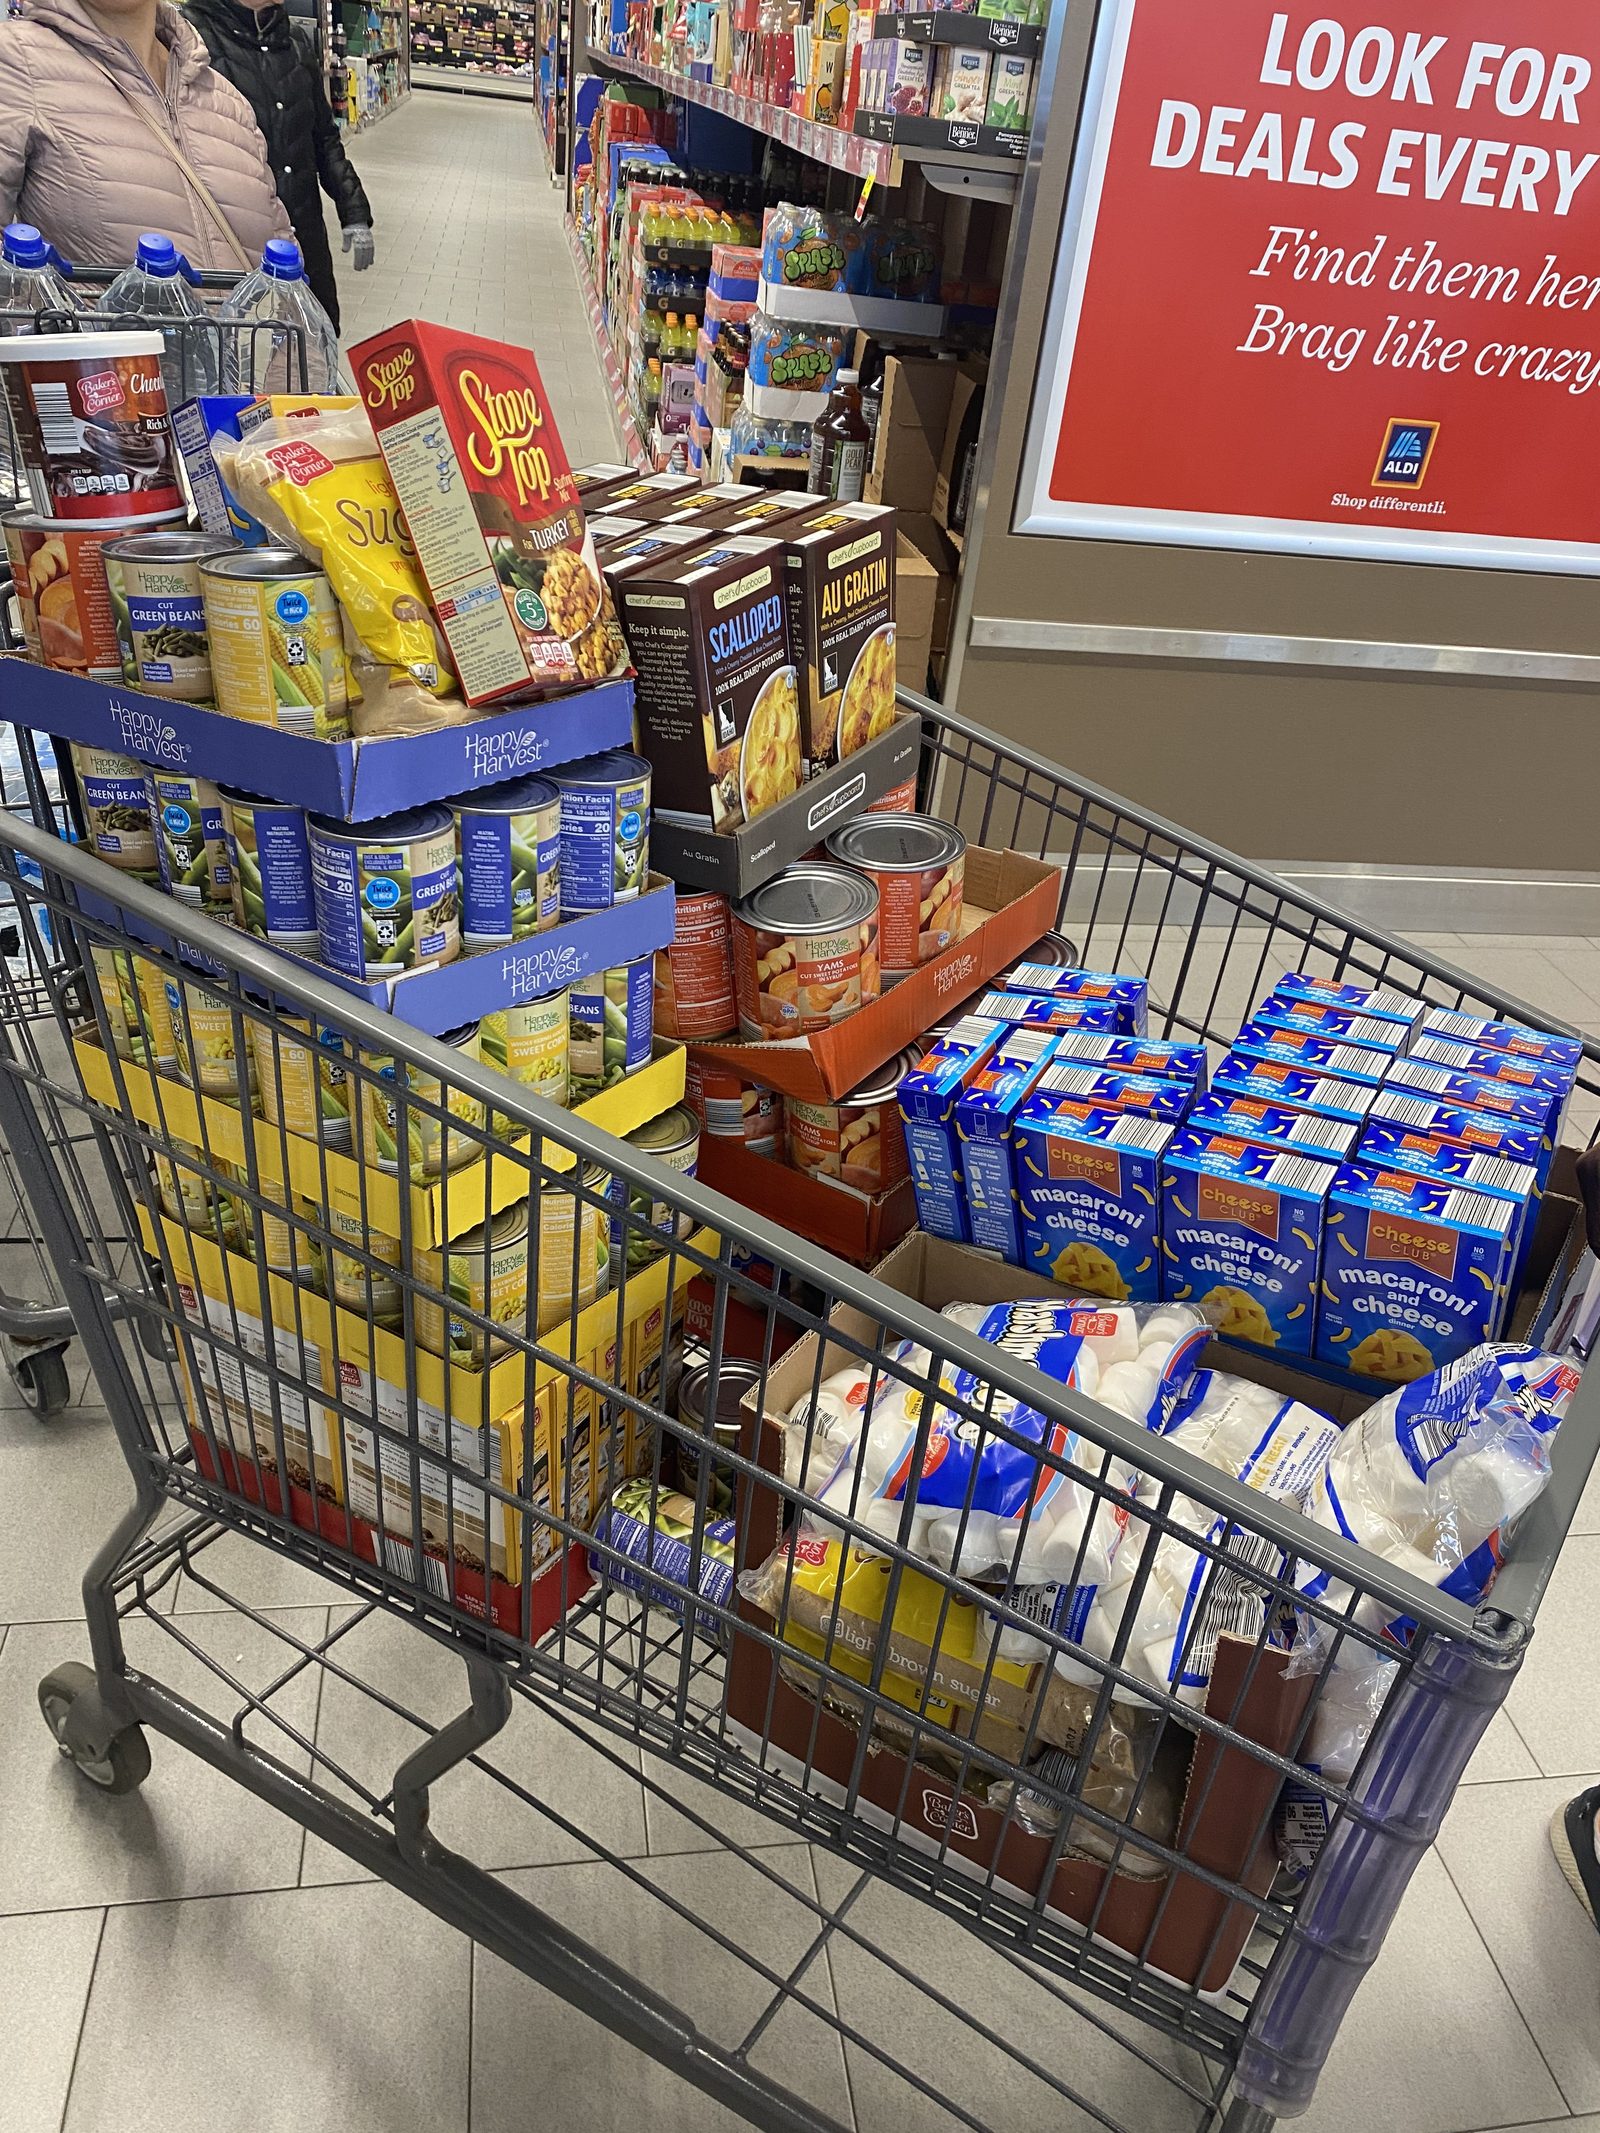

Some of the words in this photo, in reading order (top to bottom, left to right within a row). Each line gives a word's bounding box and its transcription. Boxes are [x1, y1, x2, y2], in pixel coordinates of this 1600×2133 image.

[1259, 13, 1448, 104] LOOK
[1455, 41, 1591, 124] FOR
[1150, 98, 1366, 189] DEALS
[1376, 129, 1600, 216] EVERY
[1248, 225, 1387, 287] Find
[1389, 241, 1517, 302] them
[1236, 304, 1366, 373] Brag
[1373, 315, 1467, 370] like
[81, 377, 116, 394] Baker's
[367, 347, 415, 408] Stove
[384, 374, 415, 411] Top
[86, 393, 120, 413] Corner
[146, 419, 160, 430] Rich
[458, 369, 542, 478] Stove
[272, 443, 311, 466] Baker's
[845, 449, 863, 459] GOLD
[290, 458, 328, 484] Corner
[497, 437, 551, 506] Top
[844, 459, 862, 470] PEAK
[1383, 460, 1418, 476] ALDI
[1331, 493, 1367, 509] Shop
[1369, 497, 1447, 515] differentli.
[529, 518, 569, 551] TURKEY
[831, 547, 848, 564] chef's
[852, 537, 880, 557] cupboard
[138, 571, 175, 585] Happy
[145, 580, 190, 593] Harvest
[717, 587, 736, 604] chef's
[740, 572, 769, 594] cupboard
[821, 579, 841, 619] AU
[844, 557, 888, 608] GRATIN
[132, 609, 167, 622] GREEN
[169, 609, 206, 622] BEANS
[526, 603, 536, 618] 5
[243, 619, 260, 631] 60
[629, 623, 649, 636] Keep
[650, 625, 657, 635] it
[659, 627, 689, 639] simple.
[709, 594, 782, 663] SCALLOPED
[822, 638, 836, 649] 100%
[835, 631, 849, 644] REAL
[866, 608, 888, 626] POTATOES
[657, 650, 671, 659] enjoy
[715, 682, 730, 695] 100%
[729, 676, 743, 690] REAL
[761, 648, 785, 669] POTATOES
[657, 683, 685, 692] ingredients
[109, 699, 163, 737] Happy
[670, 719, 693, 727] delicious
[121, 724, 187, 763] Harvest
[465, 728, 524, 759] Happy
[90, 756, 121, 769] Happy
[473, 743, 542, 778] Harvest
[96, 766, 136, 776] Harvest
[87, 788, 115, 801] GREEN
[585, 795, 610, 803] Facts
[594, 823, 610, 834] 20
[326, 849, 350, 860] Facts
[682, 848, 694, 858] Au
[695, 852, 720, 865] Gratin
[750, 841, 776, 863] Scalloped
[337, 880, 353, 893] 20
[416, 881, 446, 899] GREEN
[703, 899, 723, 911] Facts
[709, 927, 725, 939] 130
[805, 938, 840, 950] Happy
[811, 944, 852, 959] Harvest
[502, 945, 562, 981] Happy
[813, 971, 831, 979] SWEET
[832, 963, 858, 975] POTATOES
[817, 960, 844, 972] YAMS
[511, 959, 581, 998] Harvest
[825, 973, 843, 982] SYRUP
[933, 957, 965, 986] Happy
[937, 962, 974, 997] Harvest
[194, 1021, 226, 1031] SWEET
[289, 1050, 305, 1060] 60
[513, 1043, 546, 1058] SWEET
[1062, 1103, 1089, 1114] cheese
[1048, 1114, 1087, 1127] macaroni
[1048, 1122, 1077, 1132] cheese
[1211, 1139, 1242, 1152] cheese
[1405, 1136, 1438, 1149] cheese
[1051, 1148, 1115, 1172] cheese
[1199, 1152, 1242, 1166] macaroni
[1393, 1148, 1438, 1163] macaroni
[1395, 1154, 1429, 1167] cheese
[1067, 1163, 1100, 1179] CLUB
[1200, 1158, 1231, 1171] cheese
[1379, 1174, 1413, 1187] cheese
[1202, 1188, 1274, 1215] cheese
[1367, 1187, 1414, 1202] macaroni
[1370, 1194, 1404, 1208] cheese
[1031, 1188, 1146, 1229] macaroni
[1071, 1207, 1099, 1221] and
[1219, 1204, 1256, 1221] CLUB
[582, 1213, 594, 1224] 60
[1046, 1211, 1130, 1247] cheese
[1076, 1232, 1099, 1243] dinner
[1372, 1225, 1451, 1254] cheese
[1175, 1228, 1303, 1274] macaroni
[1221, 1249, 1250, 1265] and
[1390, 1243, 1430, 1261] CLUB
[1473, 1246, 1484, 1254] NO
[1190, 1254, 1283, 1293] cheese
[1223, 1275, 1249, 1287] dinner
[1338, 1268, 1478, 1317] macaroni
[1387, 1291, 1420, 1307] and
[685, 1311, 709, 1329] Top
[1098, 1312, 1115, 1335] Baker's
[1352, 1295, 1454, 1337] cheese
[1388, 1317, 1415, 1330] dinner
[1249, 1466, 1270, 1488] RICE
[1269, 1474, 1280, 1487] COOK
[950, 1677, 1001, 1708] sugar
